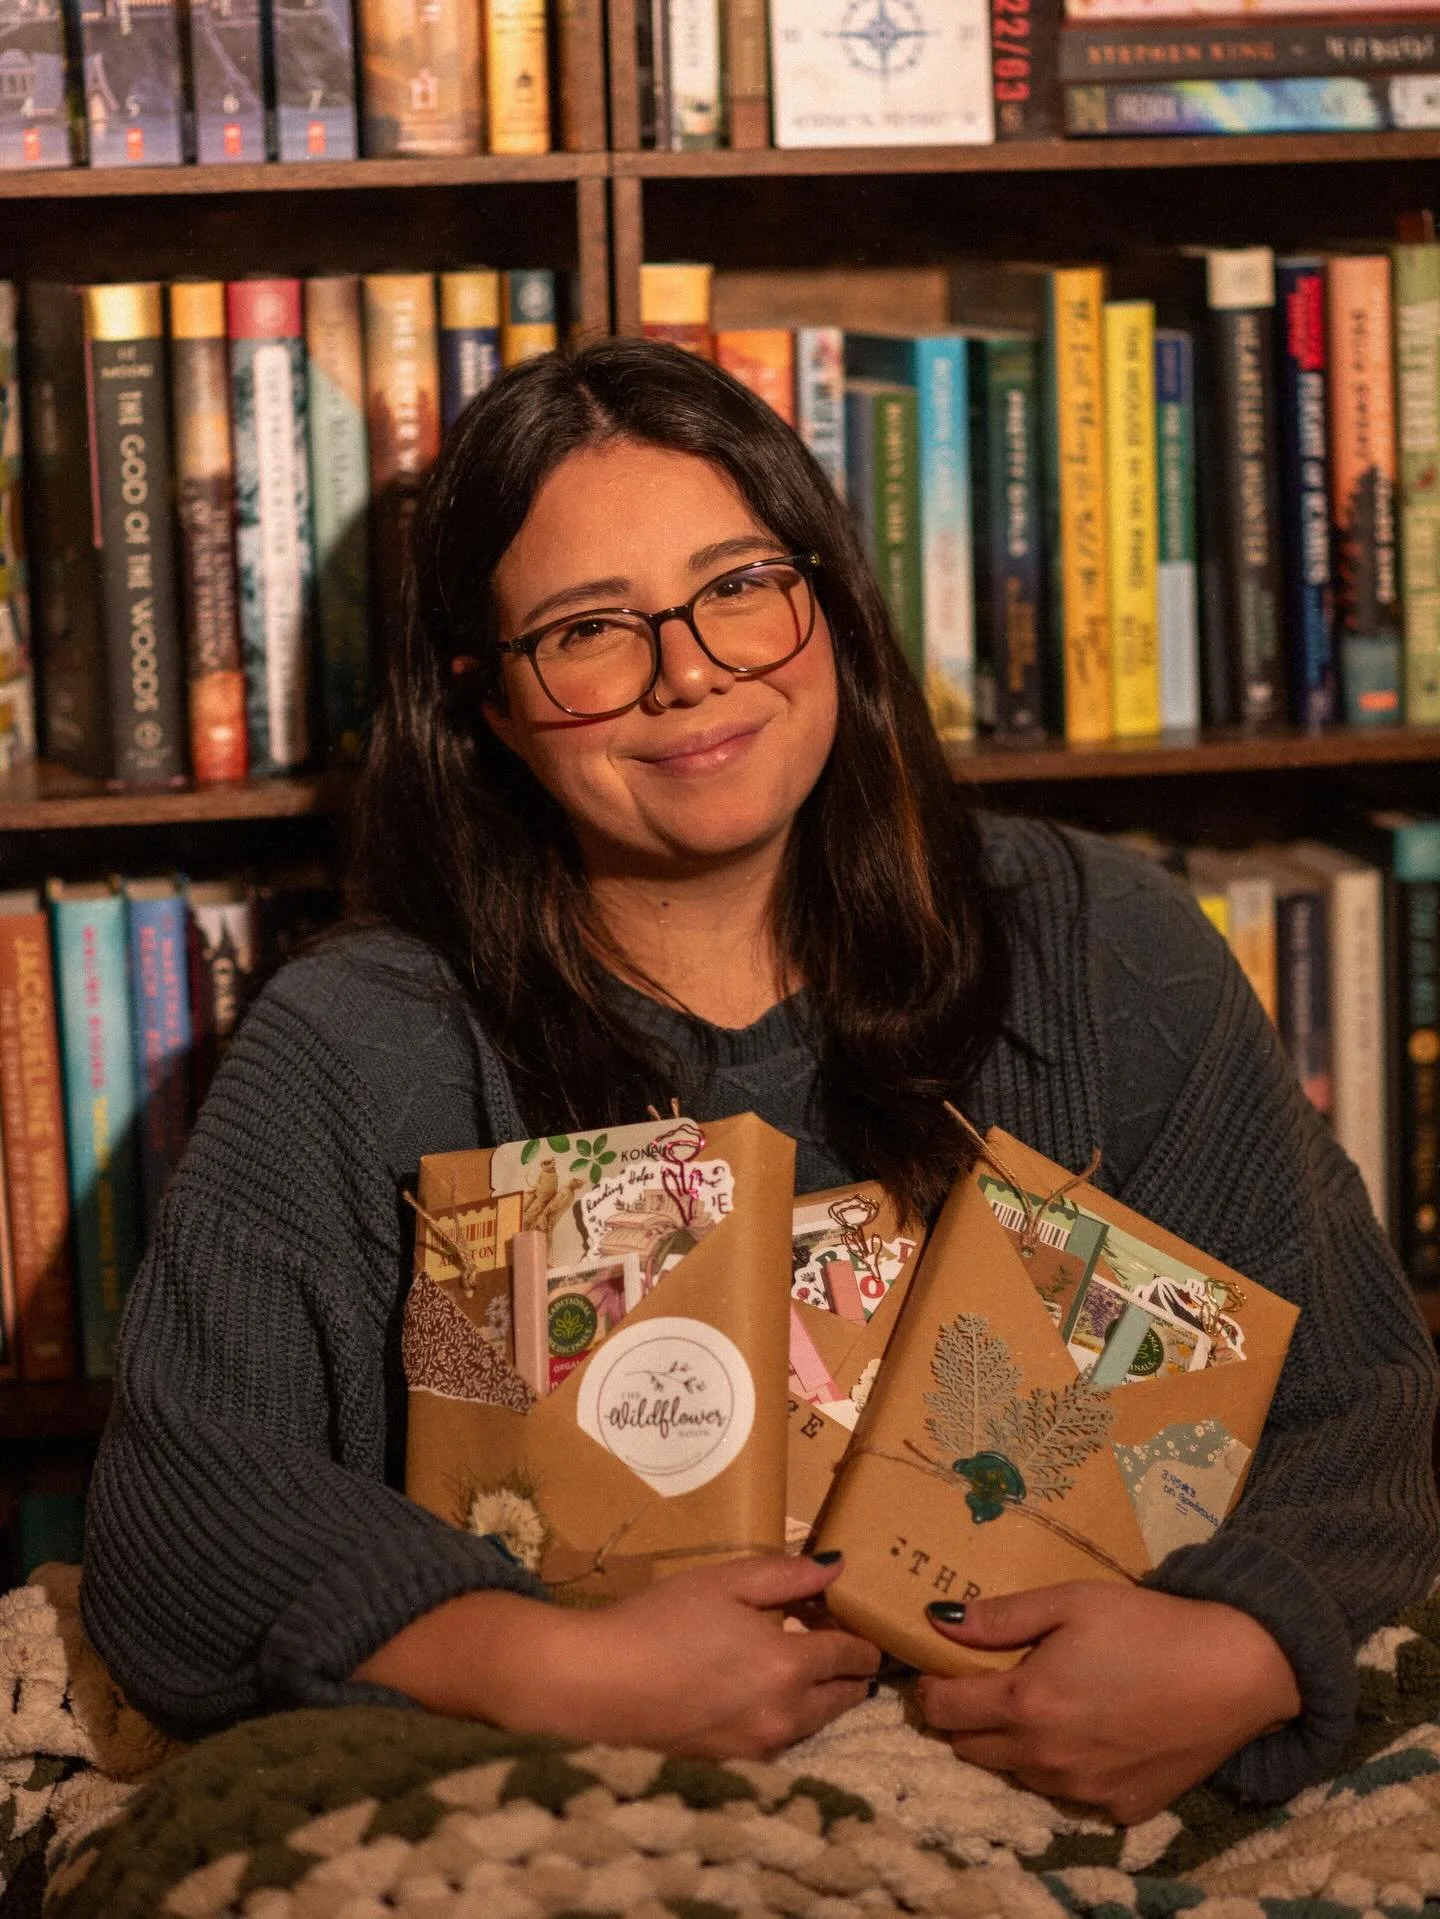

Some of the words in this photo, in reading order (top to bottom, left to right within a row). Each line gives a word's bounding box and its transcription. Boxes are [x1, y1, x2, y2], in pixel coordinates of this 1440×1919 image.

[120, 433, 148, 505] GOD
[124, 510, 150, 544] OF
[129, 596, 160, 713] WOODS
[628, 1166, 655, 1186] Helps
[605, 1396, 724, 1439] Wildflower
